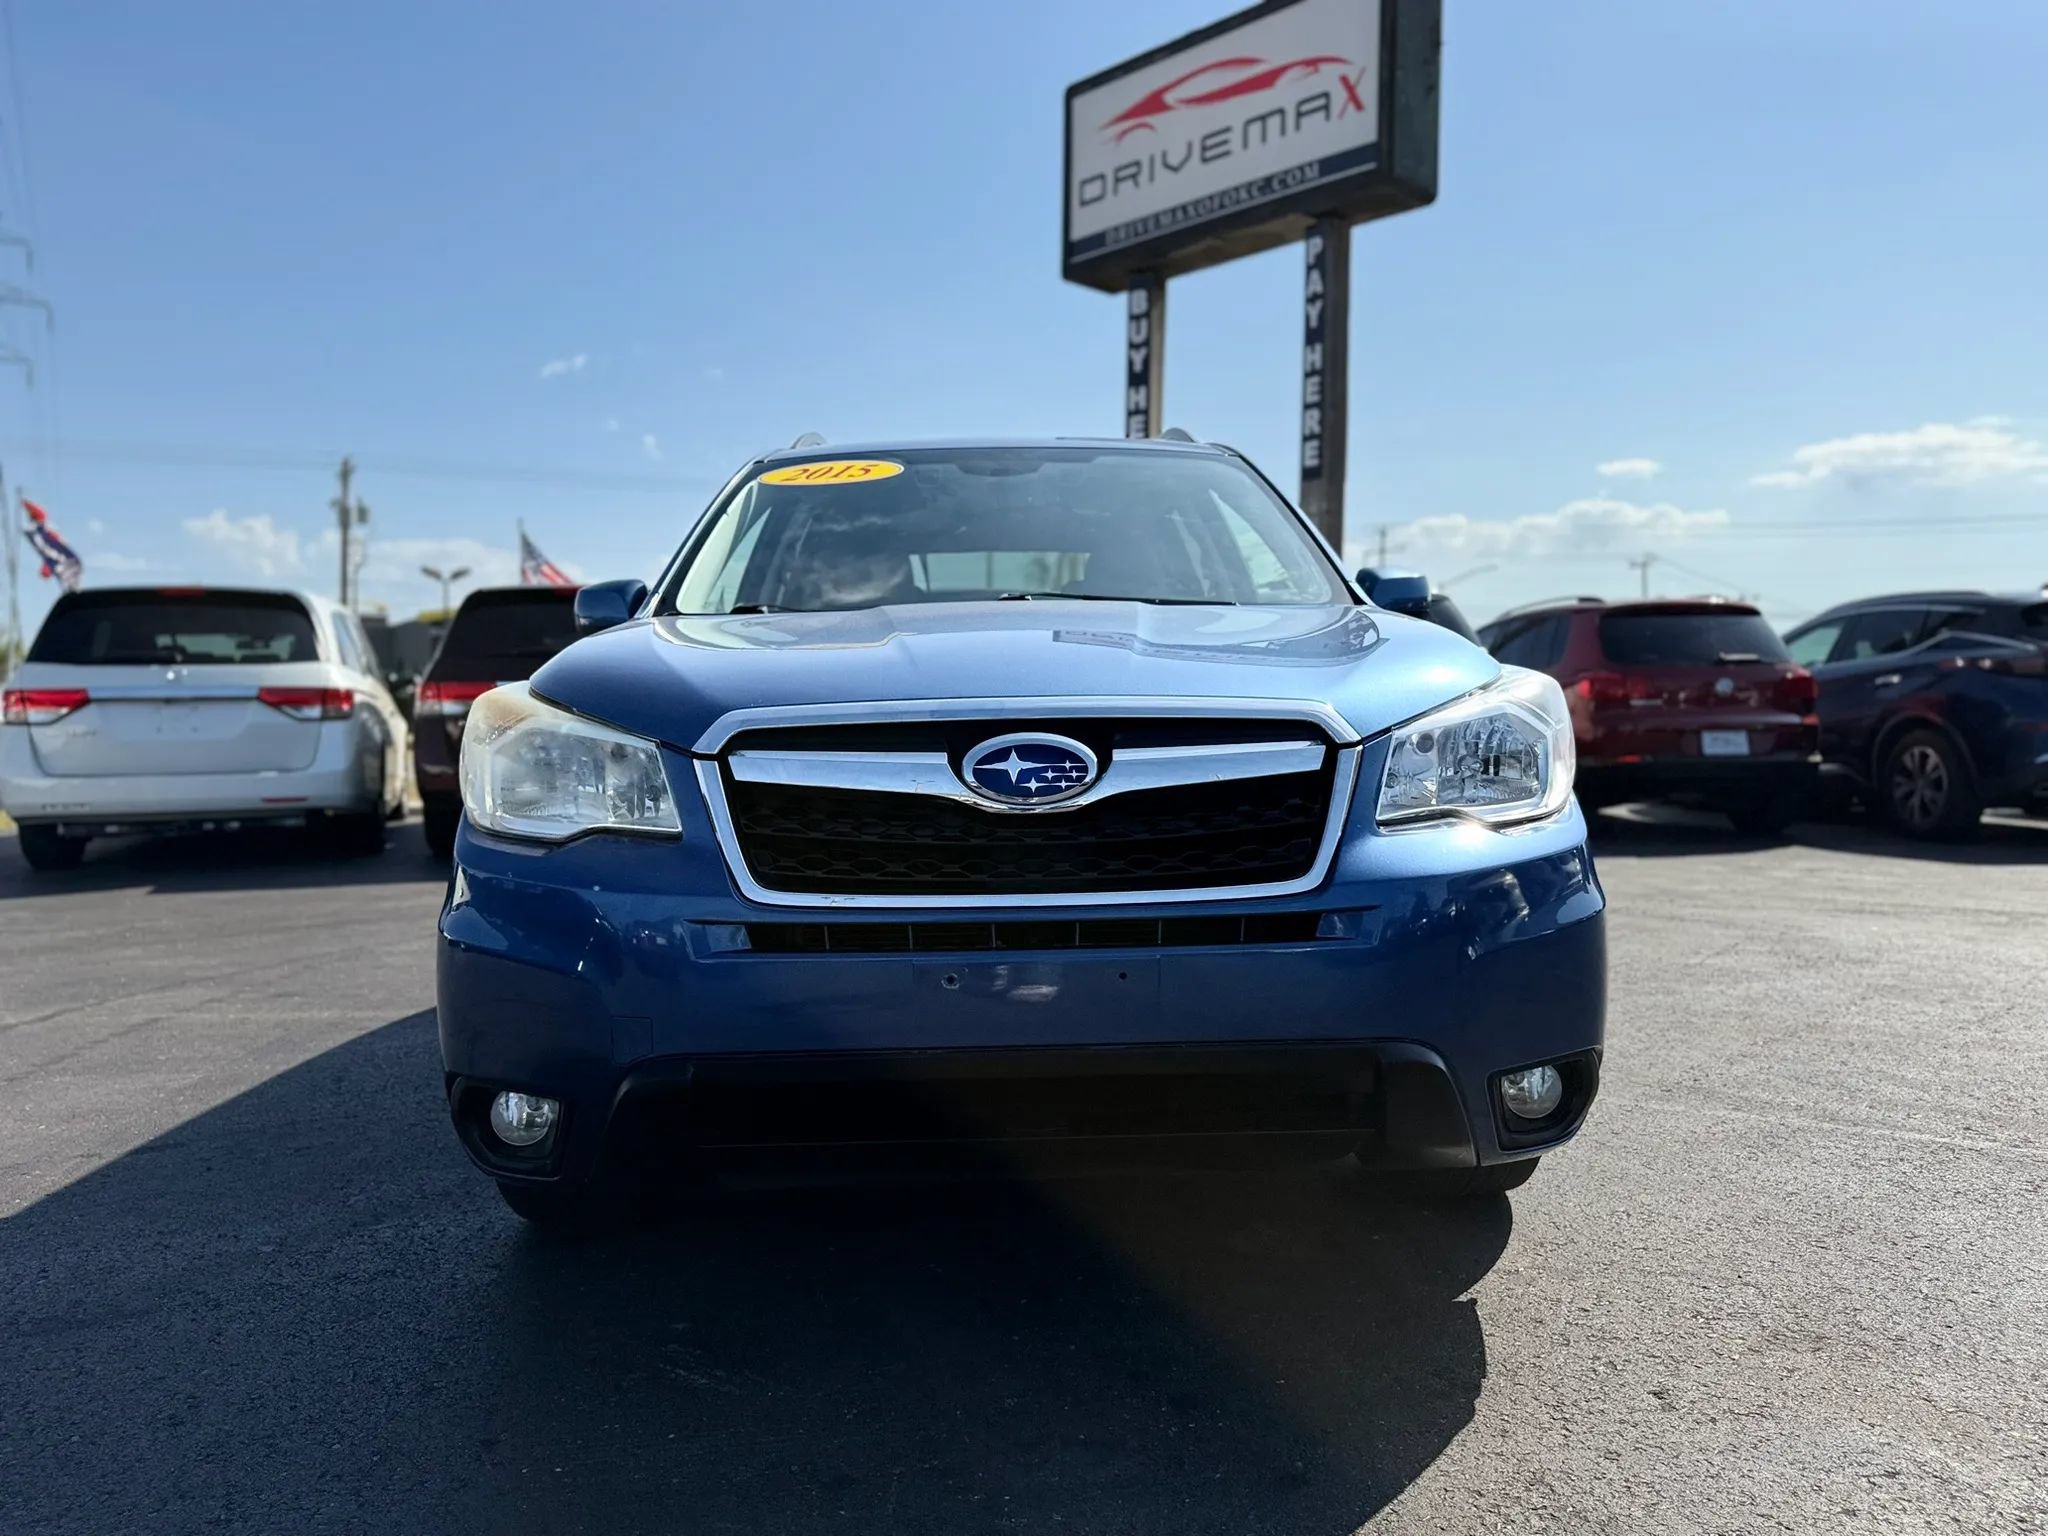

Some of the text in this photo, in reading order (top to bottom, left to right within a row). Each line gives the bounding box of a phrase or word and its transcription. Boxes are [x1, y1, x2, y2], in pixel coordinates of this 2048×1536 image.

[1078, 67, 1366, 208] DRIVEMAX
[1128, 288, 1149, 374] BUY
[1303, 235, 1324, 468] PAY HERE
[780, 463, 881, 482] 2015
